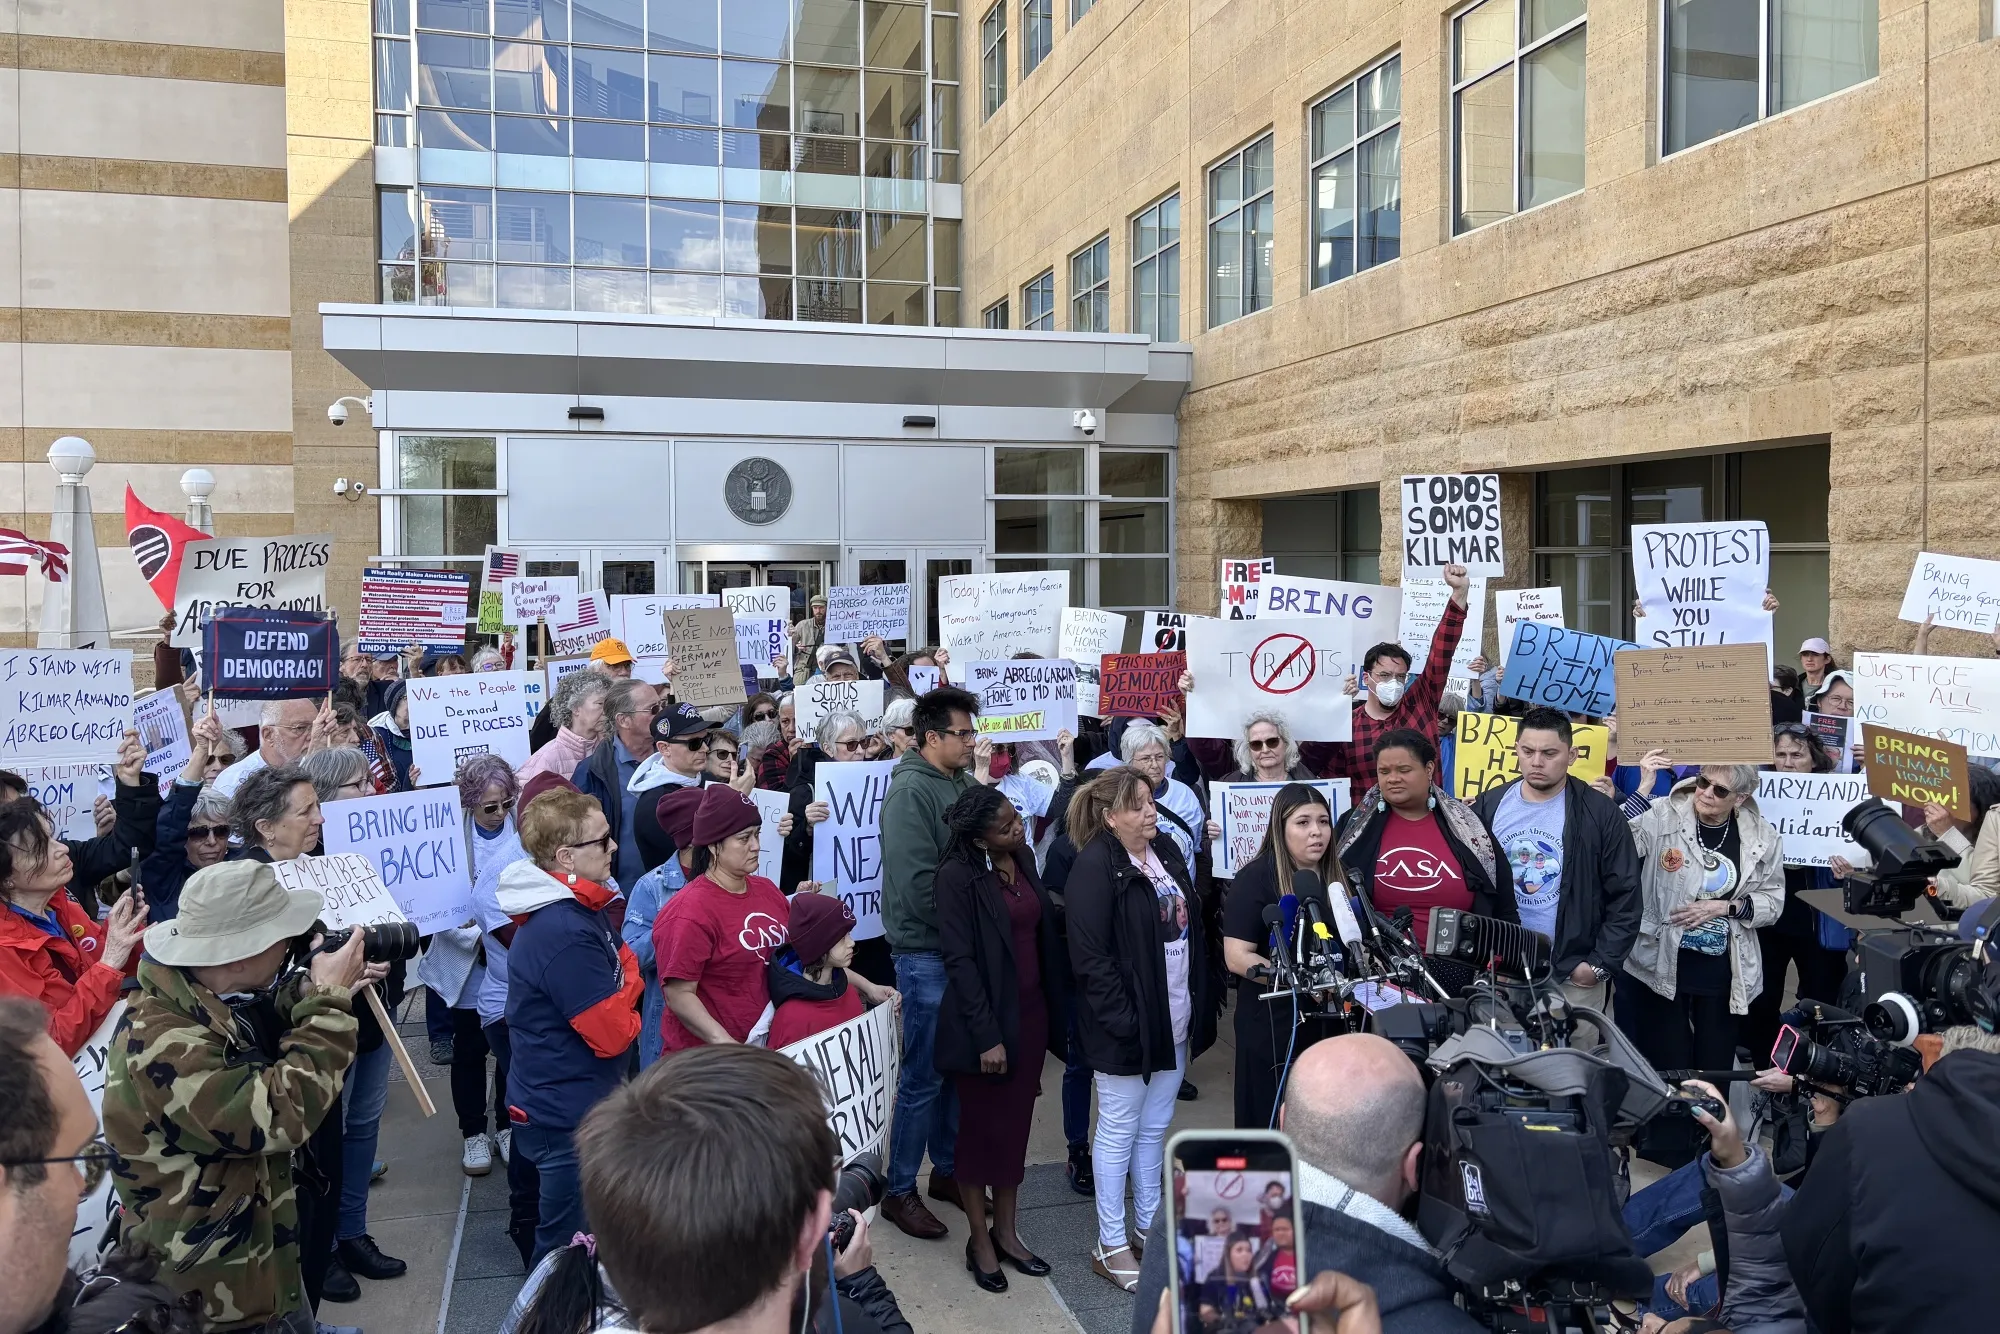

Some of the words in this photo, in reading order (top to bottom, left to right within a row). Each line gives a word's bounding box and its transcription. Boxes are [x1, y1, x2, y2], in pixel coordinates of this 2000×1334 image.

[1404, 476, 1497, 504] TODOS
[1408, 504, 1499, 535] SOMOS
[194, 548, 248, 571] DUE
[264, 542, 330, 574] PROCESS
[1406, 536, 1500, 567] KILMAR
[1643, 528, 1768, 570] PROTEST
[1225, 562, 1272, 583] FREE
[1924, 562, 1970, 587] BRING
[237, 580, 275, 600] FOR
[512, 580, 547, 595] Moral
[830, 586, 867, 599] BRING
[874, 584, 910, 596] KILMAR
[989, 582, 1016, 596] Kilmar
[1016, 584, 1039, 598] Abrego
[1040, 578, 1063, 592] Garcia
[1520, 592, 1541, 602] Free
[1662, 577, 1726, 603] WHILE
[514, 594, 561, 609] Courage
[727, 594, 776, 615] BRING
[829, 598, 868, 609] ABREGO
[872, 596, 905, 606] GARCIA
[1268, 586, 1373, 619] BRING
[1416, 600, 1445, 609] Supreme
[1516, 602, 1544, 611] Kilmar
[1928, 587, 1972, 608] Abrego
[516, 605, 556, 618] Needed
[829, 610, 862, 621] HOME
[870, 608, 888, 618] ALL
[891, 608, 908, 617] THOSE
[943, 614, 981, 625] Tomorrow
[1074, 610, 1108, 624] BRING
[1673, 608, 1710, 627] YOU
[667, 614, 701, 629] WE
[862, 618, 905, 630] DEPORTED
[244, 630, 309, 651] DEFEND
[670, 629, 701, 642] ARE
[710, 626, 733, 638] NOT
[947, 634, 973, 647] Wake
[974, 631, 985, 643] UP
[1064, 624, 1109, 639] KILMAR
[554, 636, 585, 654] BRING
[672, 644, 704, 655] NAZI
[1074, 636, 1104, 649] HOME
[672, 648, 727, 665] GERMANY
[976, 646, 1000, 660] YOU
[1114, 656, 1141, 670] THIS
[1142, 656, 1153, 669] IS
[1156, 652, 1186, 669] WHAT
[4, 656, 19, 682] I
[28, 654, 76, 677] STAND
[82, 658, 121, 679] WITH
[224, 658, 323, 679] DEMOCRACY
[558, 664, 587, 674] BRING
[702, 660, 722, 669] WE
[1220, 650, 1342, 679] TYRANTS
[1538, 657, 1602, 691] HIM
[1858, 655, 1974, 688] JUSTICE
[678, 674, 704, 682] COULD
[975, 666, 998, 680] BRING
[1002, 666, 1042, 684] ABREGO
[1044, 666, 1076, 683] GARCIA
[412, 688, 441, 701] We
[449, 687, 471, 698] the
[478, 681, 517, 696] People
[677, 686, 713, 702] FREE
[714, 685, 745, 698] KILMAR
[812, 682, 858, 703] SCOTUS
[986, 688, 1012, 705] HOME
[1014, 688, 1027, 701] TO
[1033, 684, 1049, 701] MD
[1056, 684, 1074, 700] NOW!
[20, 690, 76, 716] KILMAR
[74, 689, 130, 711] ARMANDO
[445, 700, 499, 717] Demand
[1109, 694, 1152, 711] LOOKS
[1856, 704, 1888, 720] NO
[140, 706, 169, 723] FELON
[978, 718, 990, 732] We
[1002, 718, 1012, 730] all
[1014, 710, 1046, 731] NEXT!
[1818, 717, 1837, 726] FREE
[3, 718, 68, 753] ÁBREGO
[72, 718, 125, 745] GARCÍA
[416, 724, 450, 740] DUE
[462, 716, 524, 735] PROCESS
[1818, 726, 1836, 734] NOW
[144, 750, 173, 769] BRING
[456, 745, 489, 755] HANDS
[1875, 736, 1949, 764] BRING
[164, 758, 190, 775] Garcia
[1876, 753, 1952, 781] KILMAR
[1896, 770, 1943, 789] HOME
[29, 782, 74, 806] ROM
[1891, 782, 1959, 811] NOW!
[1233, 810, 1253, 820] WHAT
[1254, 811, 1268, 824] YOU
[1802, 807, 1813, 817] in
[348, 804, 418, 843] BRING
[423, 802, 456, 831] HIM
[1238, 822, 1249, 833] DO
[1232, 836, 1257, 855] WE
[1501, 829, 1527, 847] Kilmar
[1528, 827, 1555, 841] Abrego
[380, 837, 456, 888] BACK!
[1374, 859, 1462, 880] CASA
[278, 854, 377, 891] EMEMBER
[325, 874, 383, 911] SPIRIT
[1516, 894, 1532, 906] With
[1533, 898, 1547, 906] his
